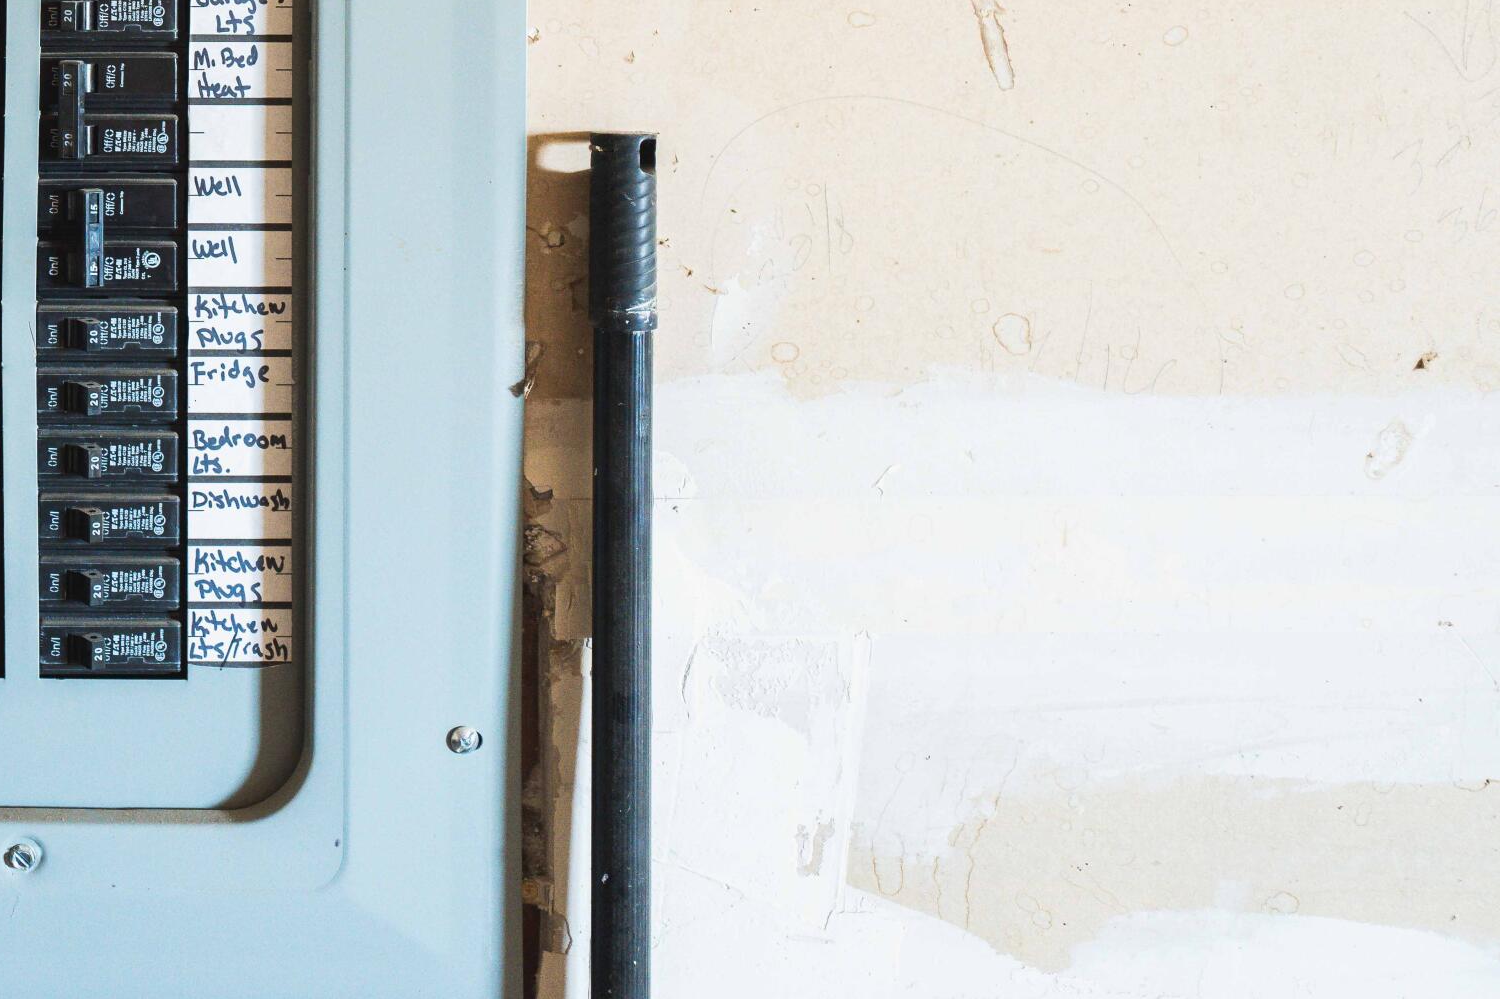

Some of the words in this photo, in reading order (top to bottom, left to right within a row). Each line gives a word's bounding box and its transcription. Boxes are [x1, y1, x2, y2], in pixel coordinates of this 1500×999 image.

[64, 9, 72, 22] 20
[197, 72, 251, 99] Heat
[194, 175, 242, 197] Well
[90, 203, 98, 215] 15
[192, 236, 237, 264] Well
[90, 330, 98, 344] 20
[190, 359, 270, 388] Fridge
[90, 392, 99, 406] 20
[192, 426, 286, 450] Bedroom
[91, 457, 100, 471] 20
[192, 489, 290, 511] Dishwash
[92, 522, 101, 536] 20
[93, 584, 102, 599] 20
[94, 647, 103, 661] 20
